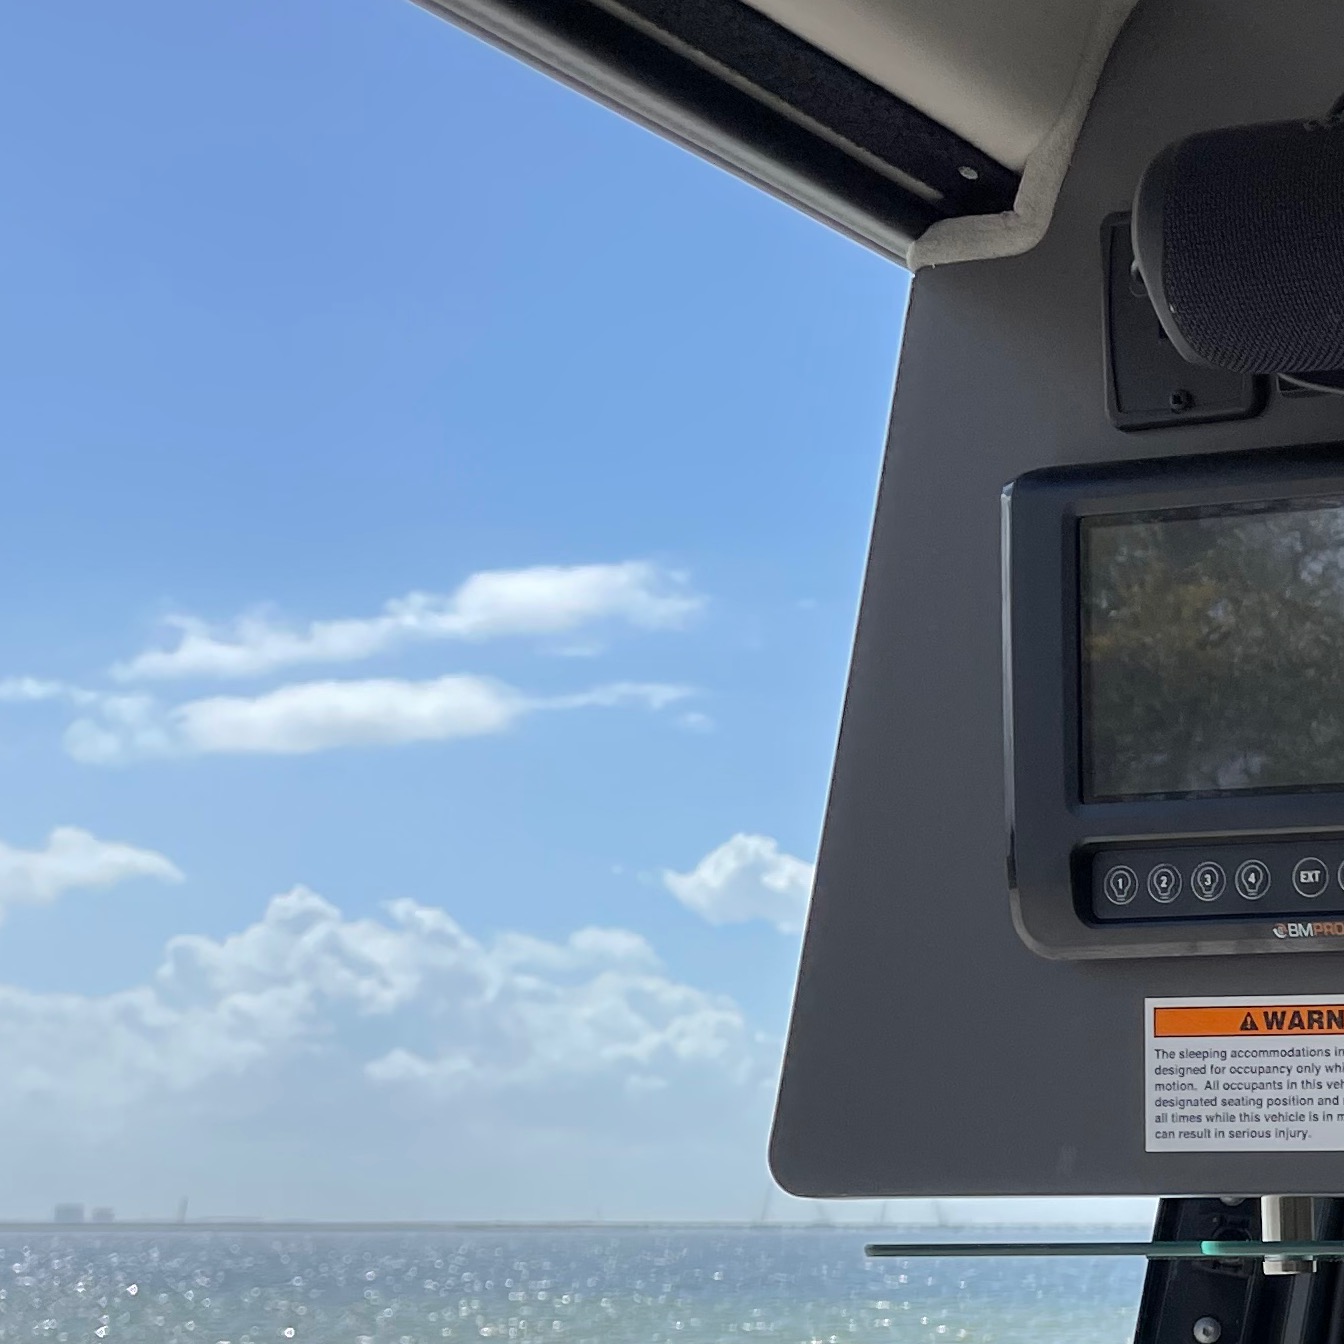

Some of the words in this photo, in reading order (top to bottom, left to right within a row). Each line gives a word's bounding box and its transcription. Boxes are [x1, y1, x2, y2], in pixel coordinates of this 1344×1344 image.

[1300, 870, 1321, 883] EXT
[1287, 922, 1344, 937] BMPRO
[1153, 1047, 1176, 1059] The
[1178, 1047, 1227, 1062] sleeping
[1230, 1045, 1331, 1059] accommodations
[1334, 1045, 1344, 1057] in
[1154, 1063, 1206, 1078] designed
[1209, 1063, 1226, 1074] for
[1229, 1064, 1293, 1077] occupancy
[1295, 1062, 1321, 1076] only
[1154, 1079, 1197, 1091] motion.
[1203, 1079, 1219, 1090] All
[1222, 1079, 1283, 1093] occupants
[1286, 1078, 1297, 1090] in
[1300, 1078, 1323, 1090] this
[1154, 1095, 1217, 1110] designated
[1220, 1095, 1263, 1109] seating
[1266, 1094, 1314, 1109] position
[1317, 1094, 1339, 1106] and
[1154, 1112, 1168, 1123] all
[1170, 1111, 1202, 1123] times
[1205, 1111, 1236, 1123] while
[1238, 1111, 1260, 1122] this
[1263, 1111, 1305, 1122] vehicle
[1308, 1110, 1319, 1122] is
[1322, 1110, 1333, 1122] in
[1154, 1130, 1175, 1139] can
[1178, 1128, 1211, 1139] result
[1214, 1127, 1225, 1138] in
[1227, 1127, 1271, 1139] serious
[1274, 1127, 1311, 1141] injury.
